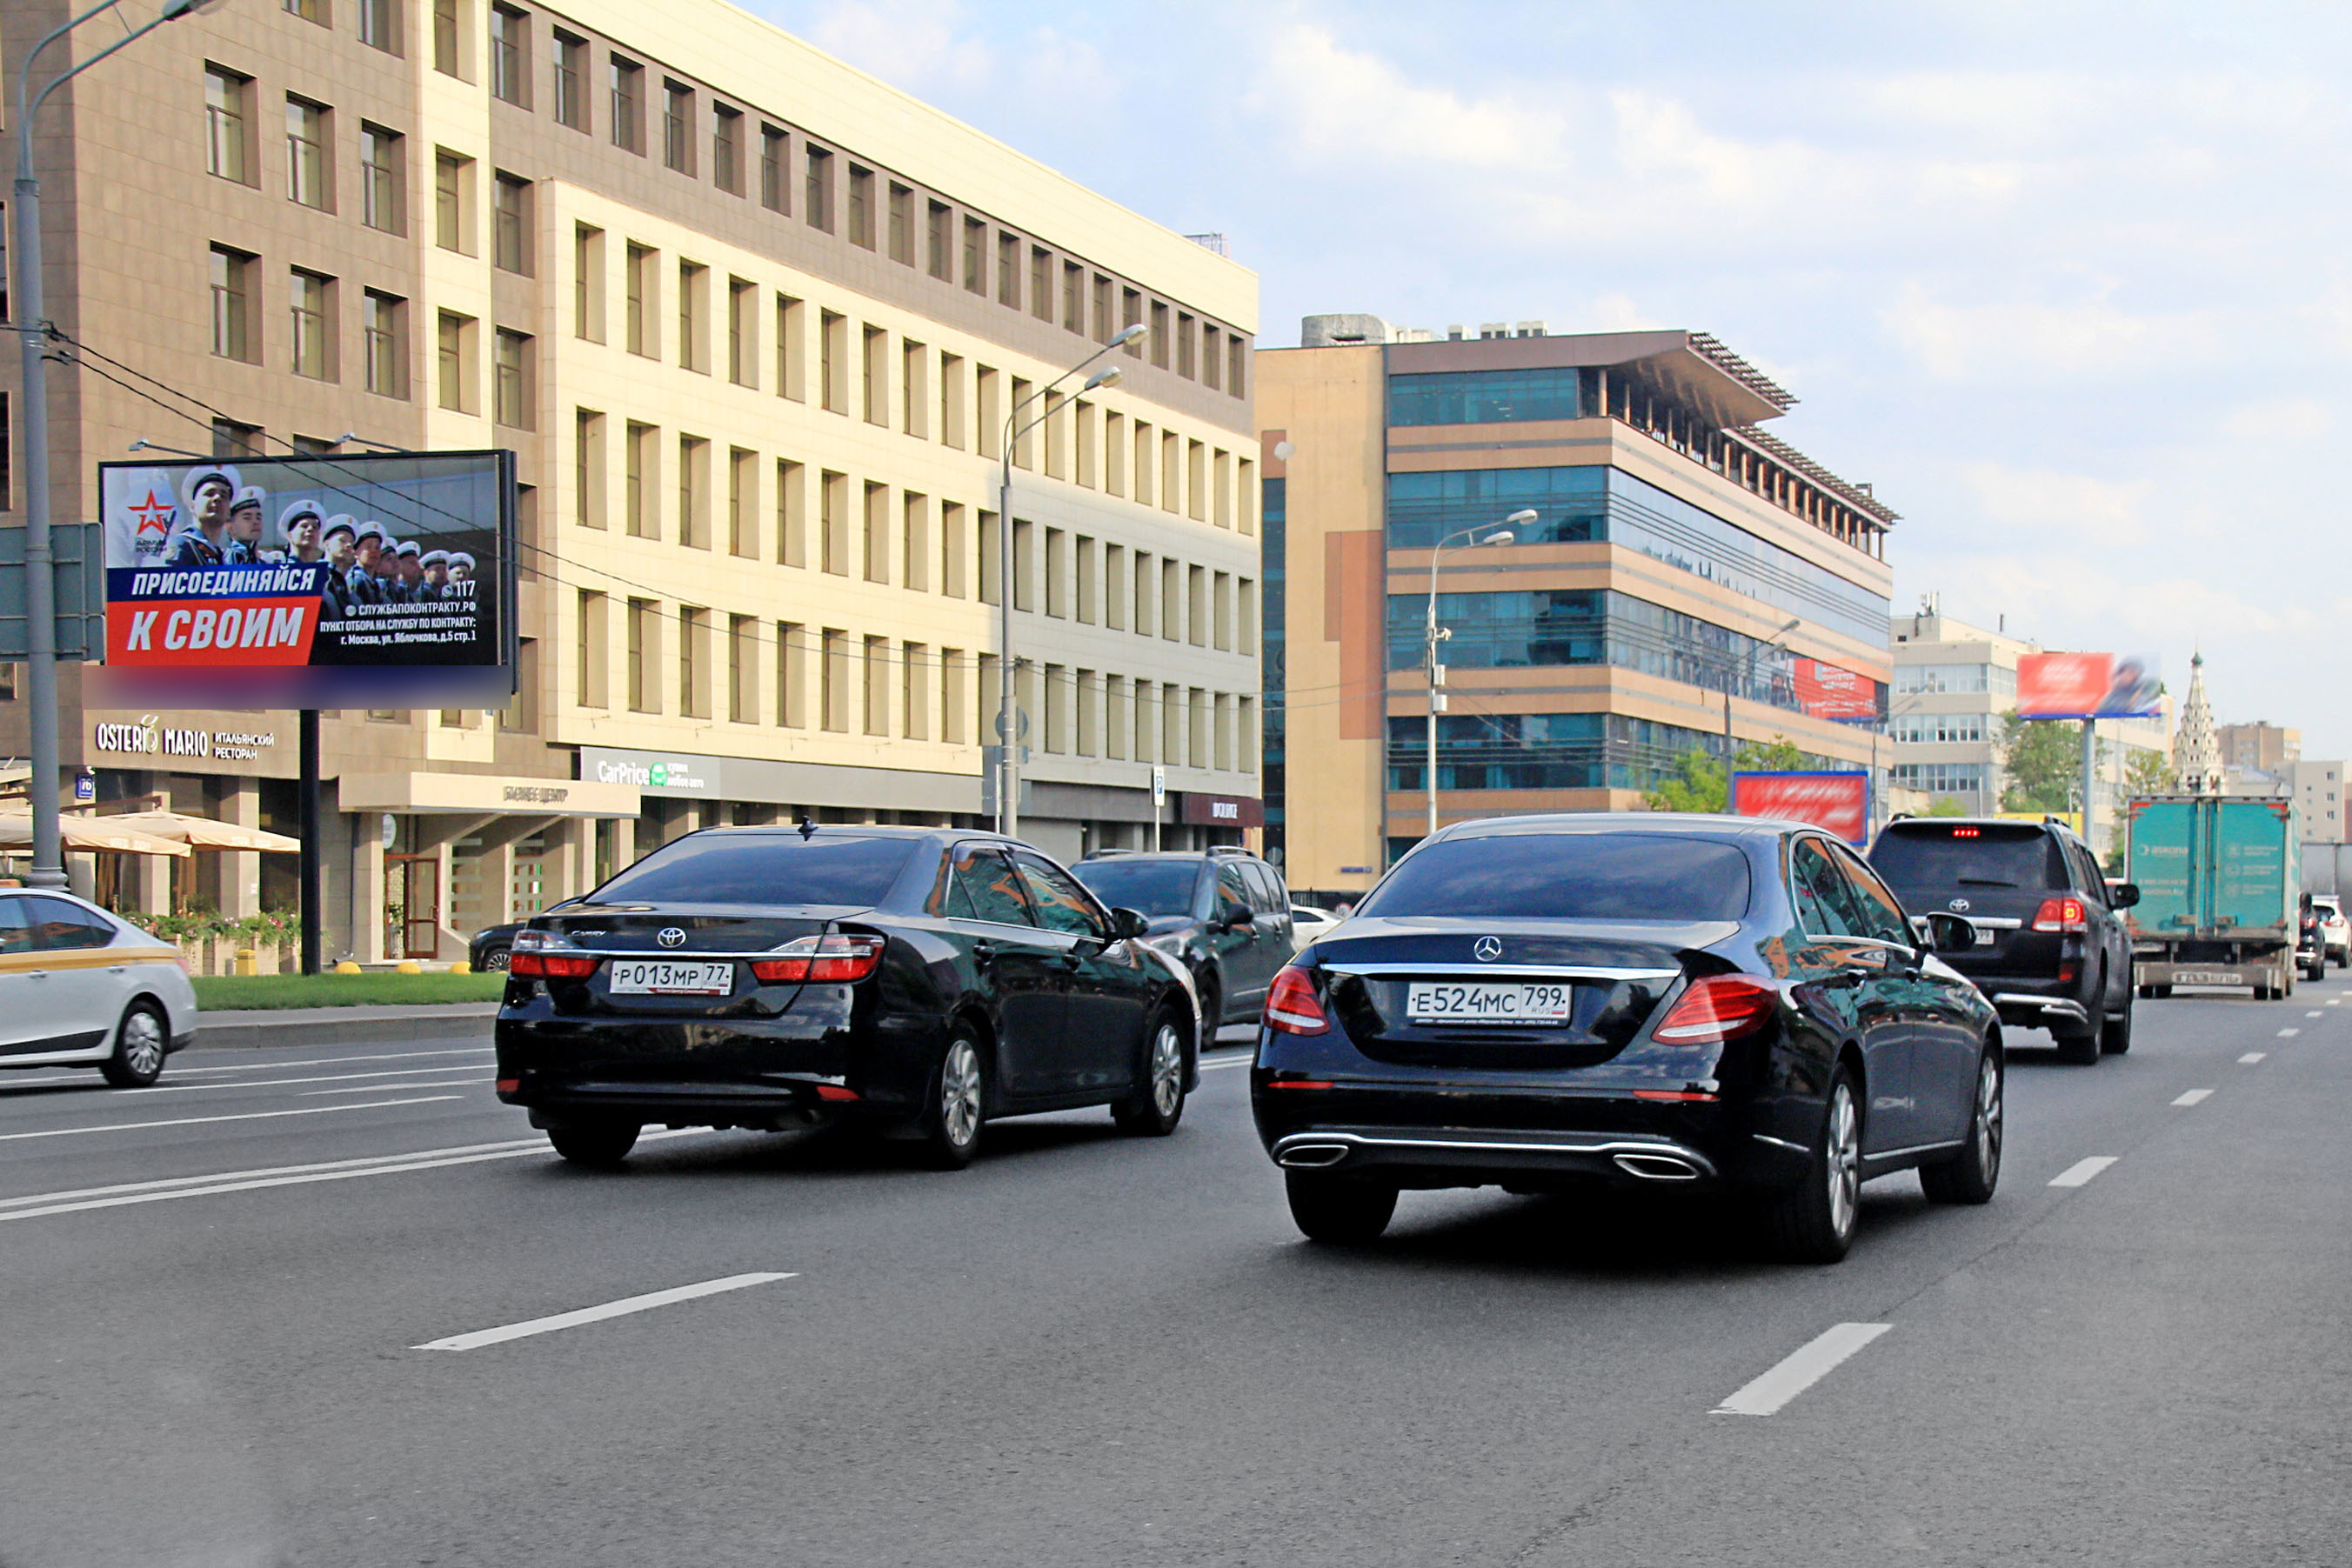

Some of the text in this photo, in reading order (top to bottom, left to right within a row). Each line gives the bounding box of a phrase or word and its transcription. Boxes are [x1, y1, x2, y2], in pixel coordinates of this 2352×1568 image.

[131, 565, 317, 595] ПРИСОЕДИНЯЙСЯ
[455, 580, 476, 597] 117
[358, 601, 477, 616] СЛУЖБАПОКОНТРАКТУ.РФ
[127, 606, 304, 651] К СВОИМ
[320, 616, 477, 632] ПУНКТ ОТБОРА НА СЛУЖБУ ПО КОНТРАКТУ:
[348, 633, 382, 645] Москва,
[382, 635, 394, 646] ул.
[454, 631, 471, 643] стр.
[471, 630, 477, 641] 1
[164, 729, 208, 757] MARIO
[215, 732, 275, 747] ИТАЛЬЯНСКИЙ
[215, 747, 257, 759] РЕСТОРАН
[597, 760, 651, 784] CarPrice
[1531, 1006, 1551, 1016] RUS
